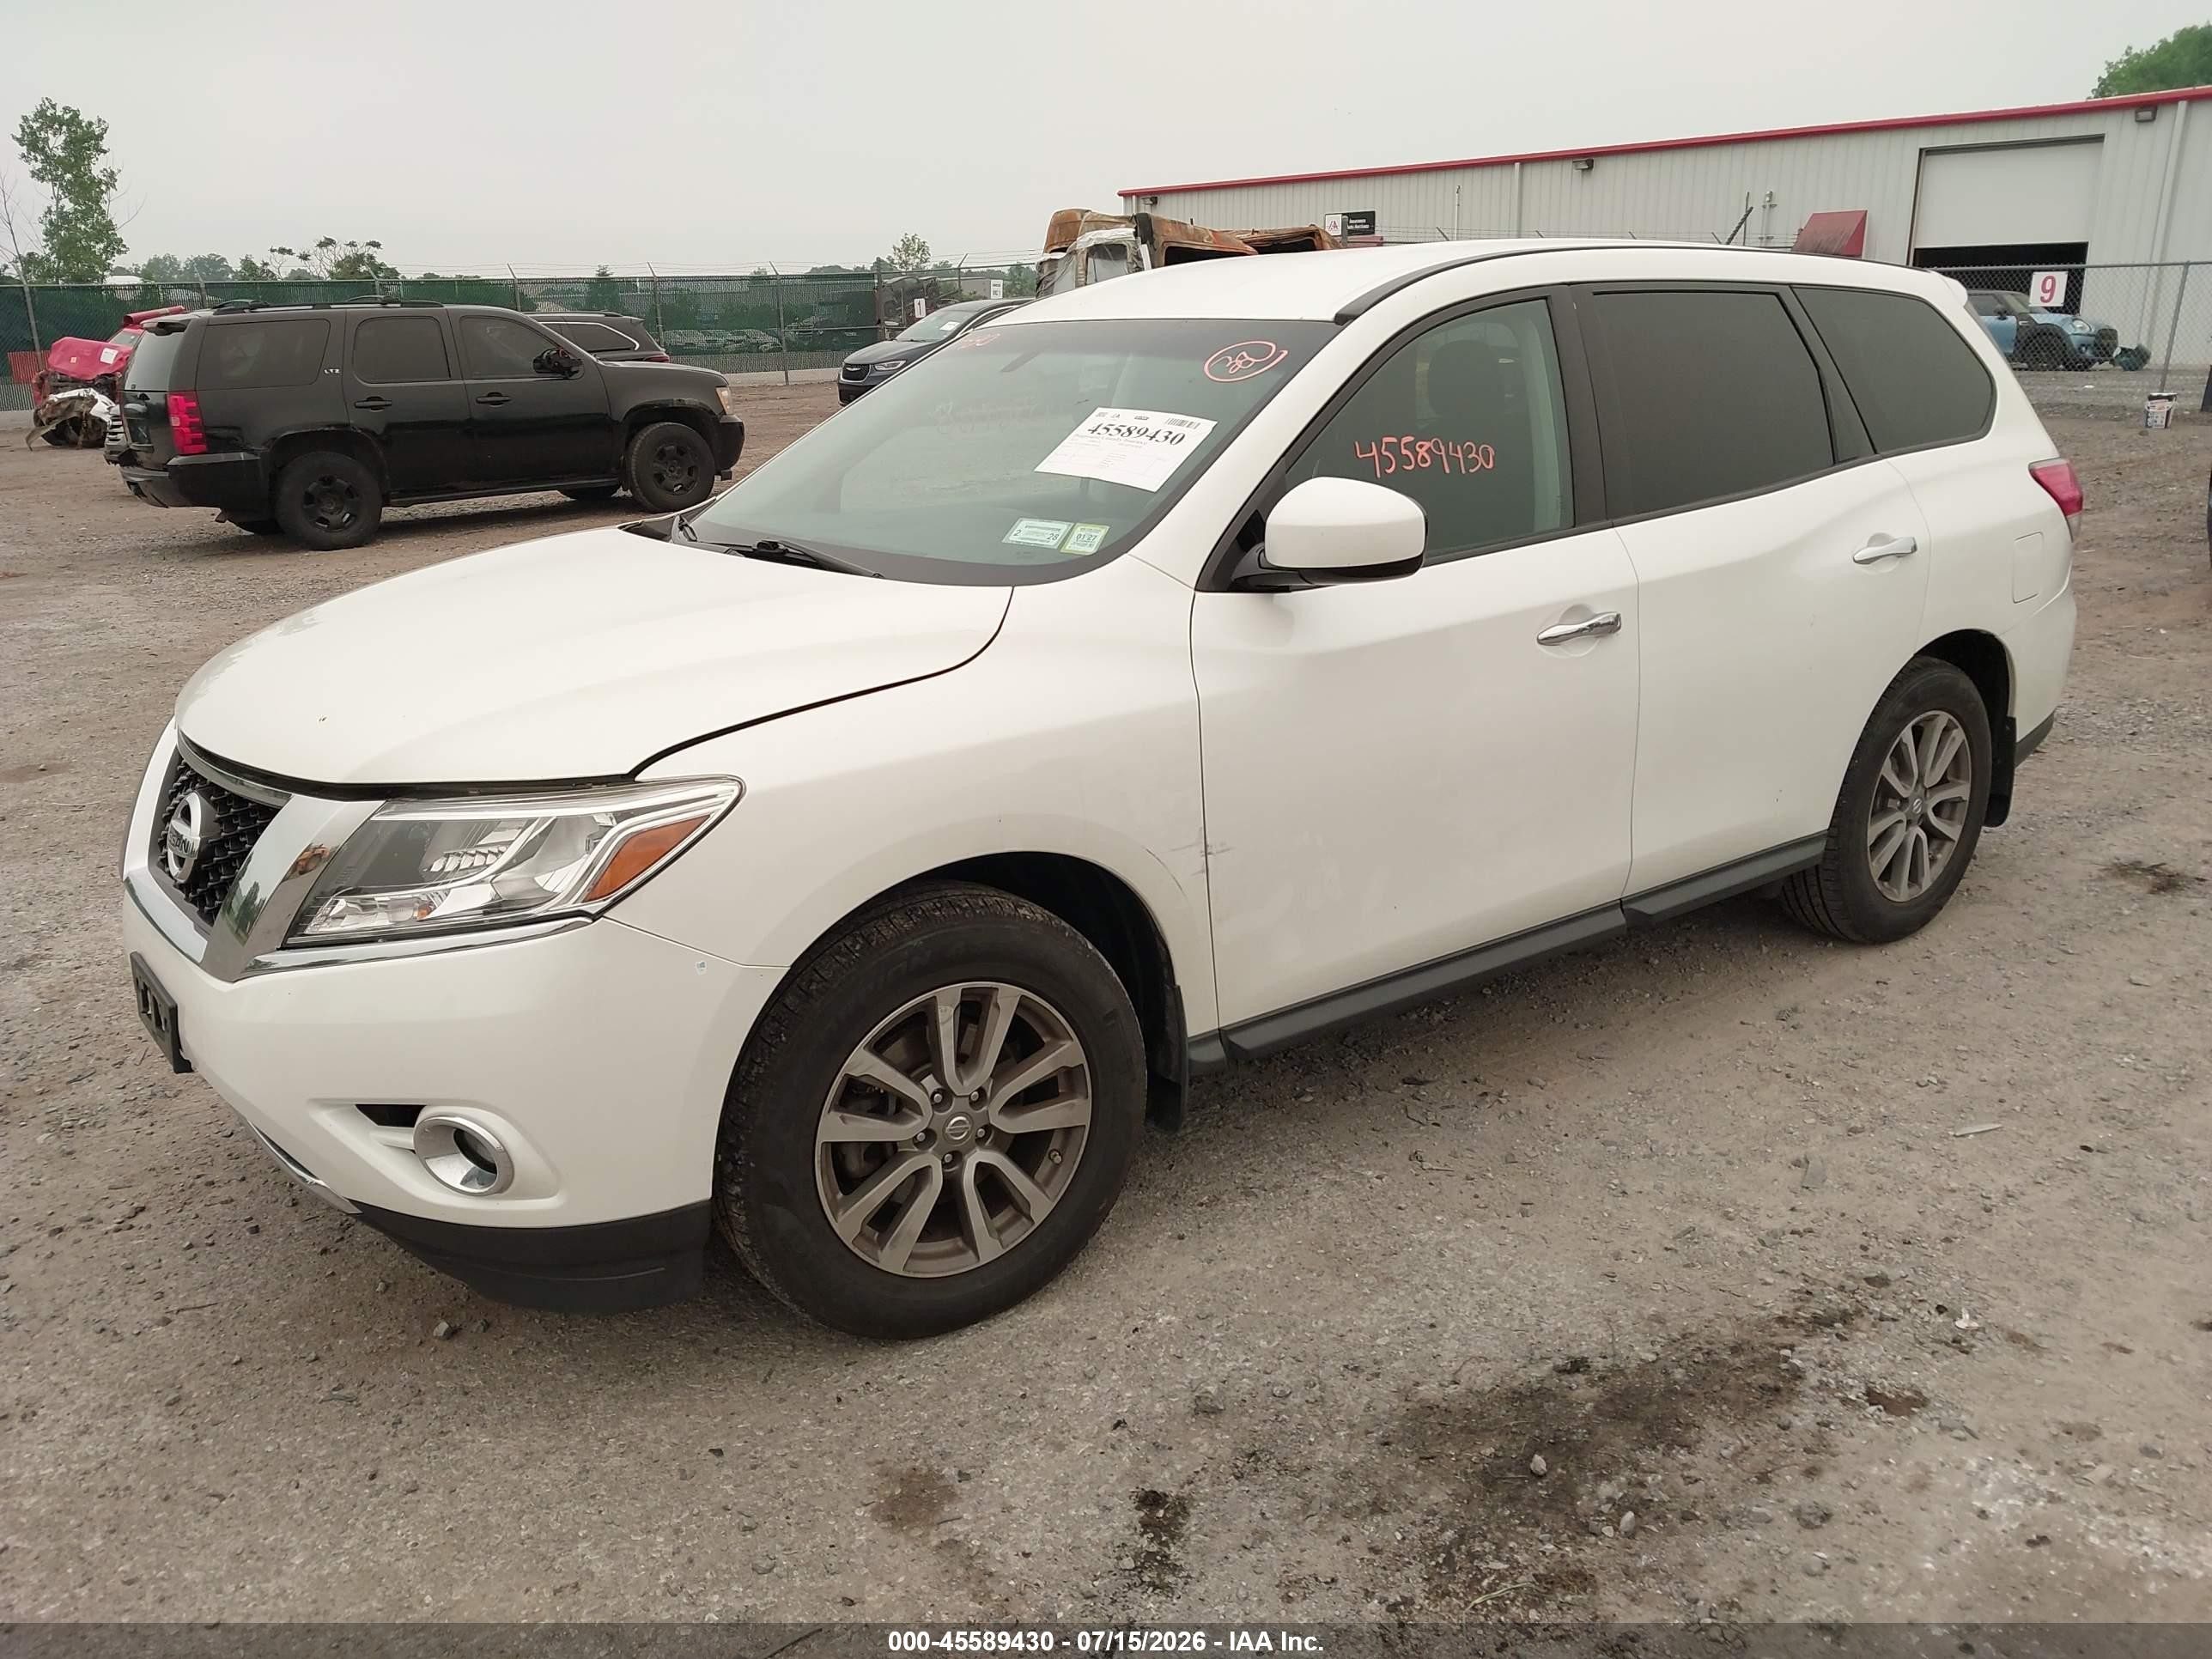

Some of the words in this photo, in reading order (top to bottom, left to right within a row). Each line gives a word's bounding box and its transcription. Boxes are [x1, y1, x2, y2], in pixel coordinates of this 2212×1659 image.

[2039, 275, 2057, 303] 9
[1087, 422, 1187, 446] 45589430
[1354, 435, 1495, 478] 45589430
